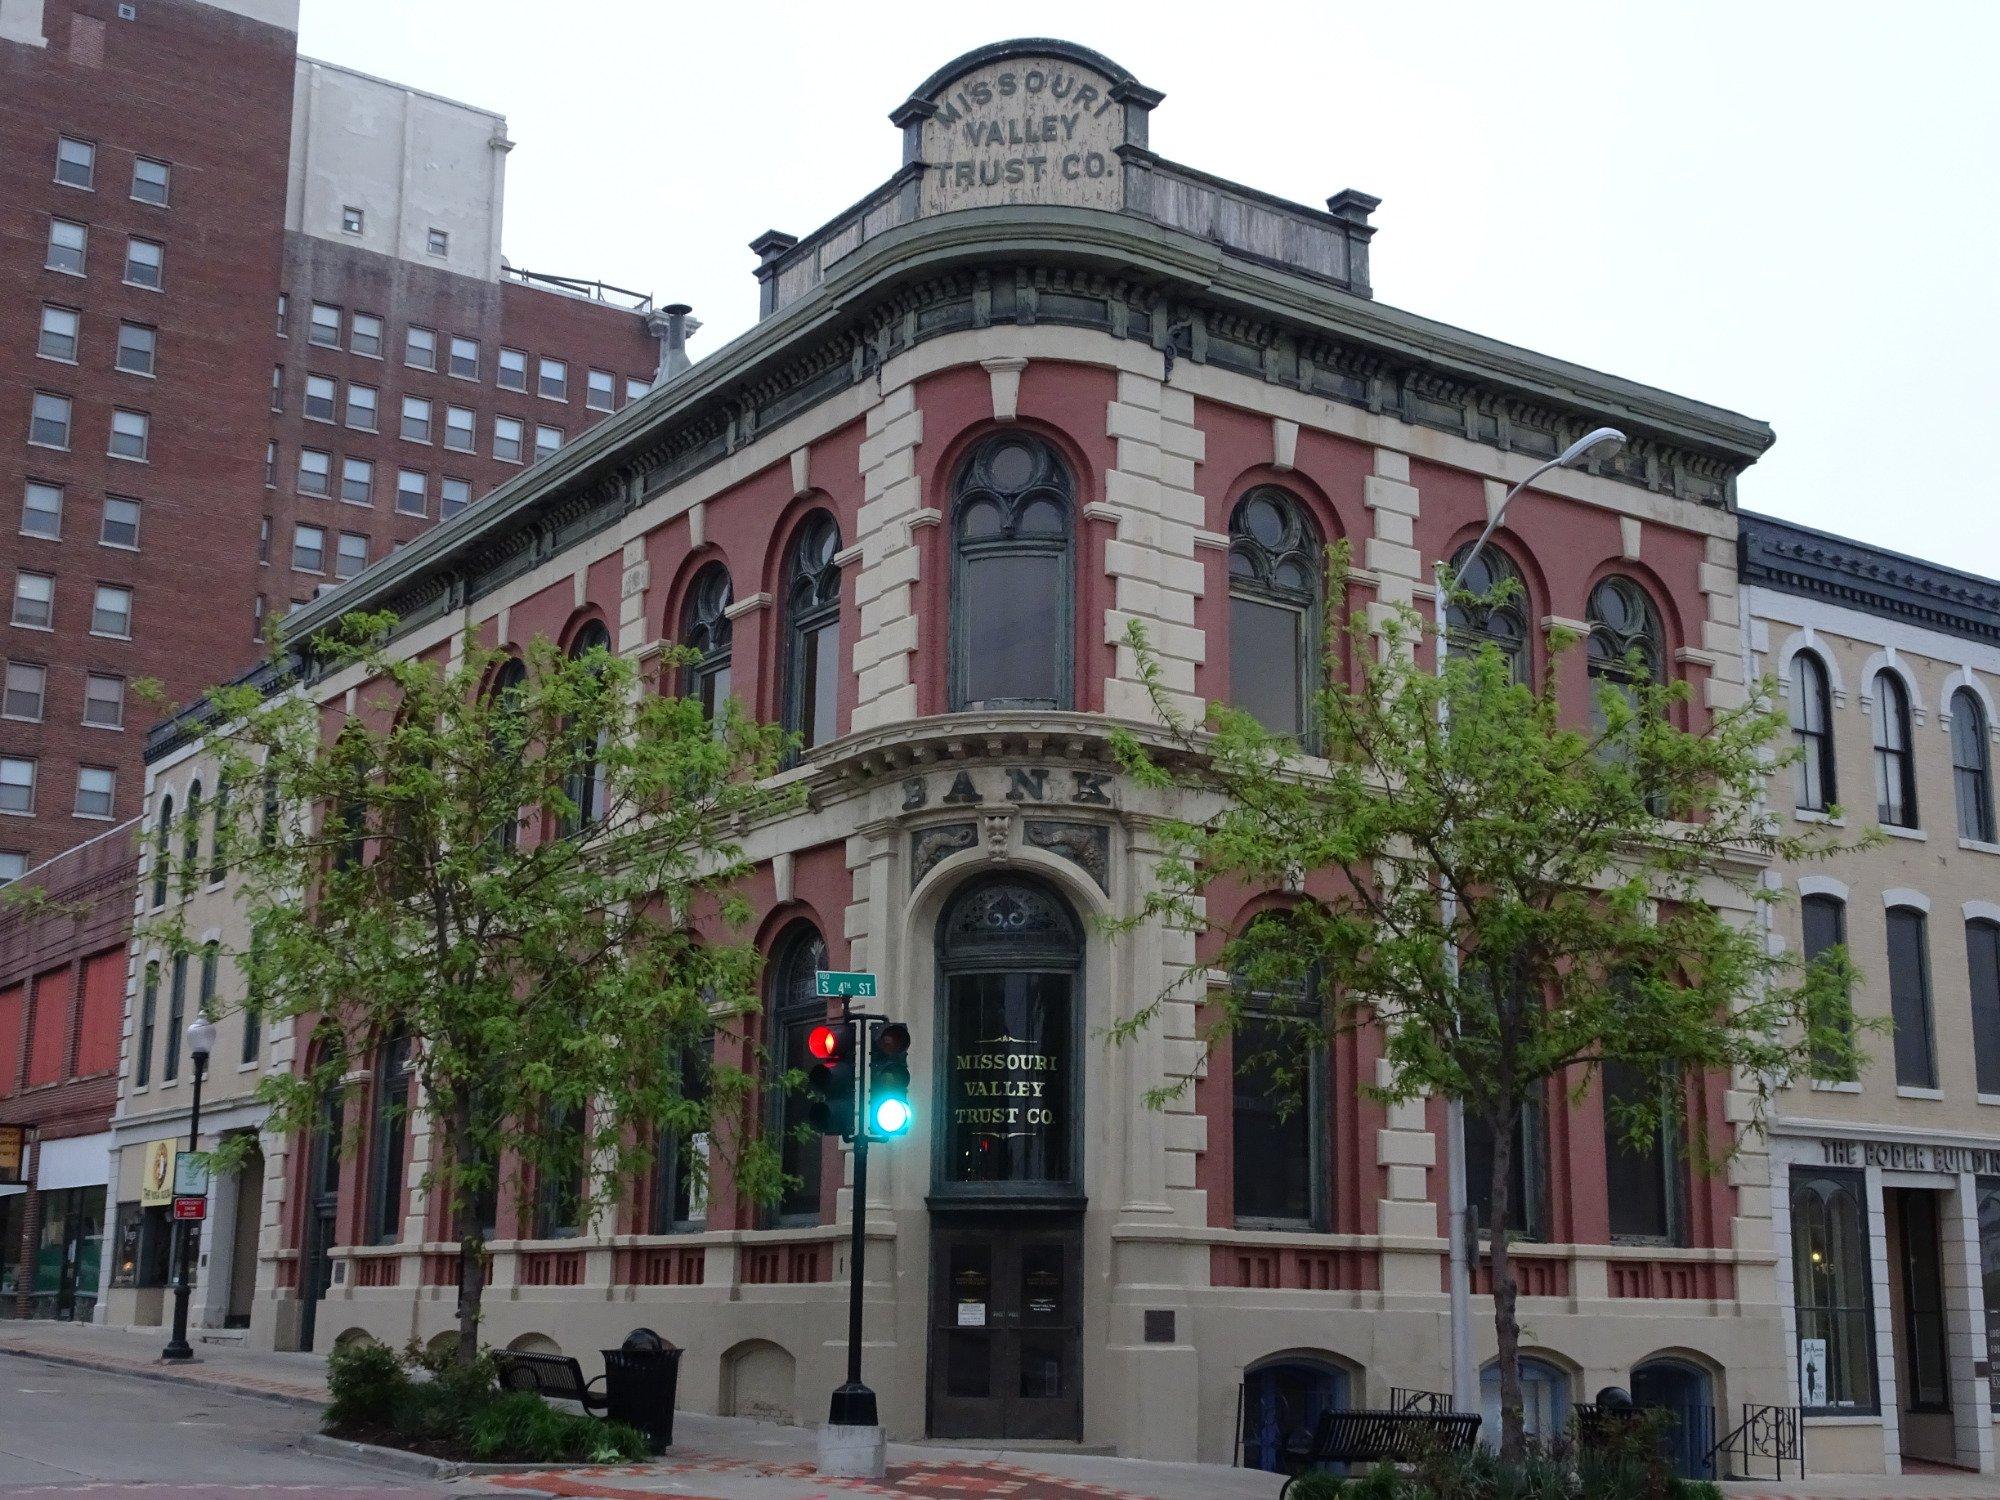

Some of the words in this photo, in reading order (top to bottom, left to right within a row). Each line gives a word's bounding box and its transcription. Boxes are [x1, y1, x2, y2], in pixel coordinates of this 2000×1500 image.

[933, 70, 1113, 130] MISSOURI
[963, 112, 1079, 147] VALLEY
[931, 155, 1047, 188] TRUST
[1062, 151, 1113, 180] CO.
[901, 768, 1114, 812] BANK
[822, 981, 829, 993] S
[858, 982, 871, 995] ST
[956, 1054, 1058, 1071] MISSOURI
[964, 1081, 1045, 1097] VALLEY
[955, 1108, 1019, 1124] TRUST
[1821, 1139, 1857, 1165] THE
